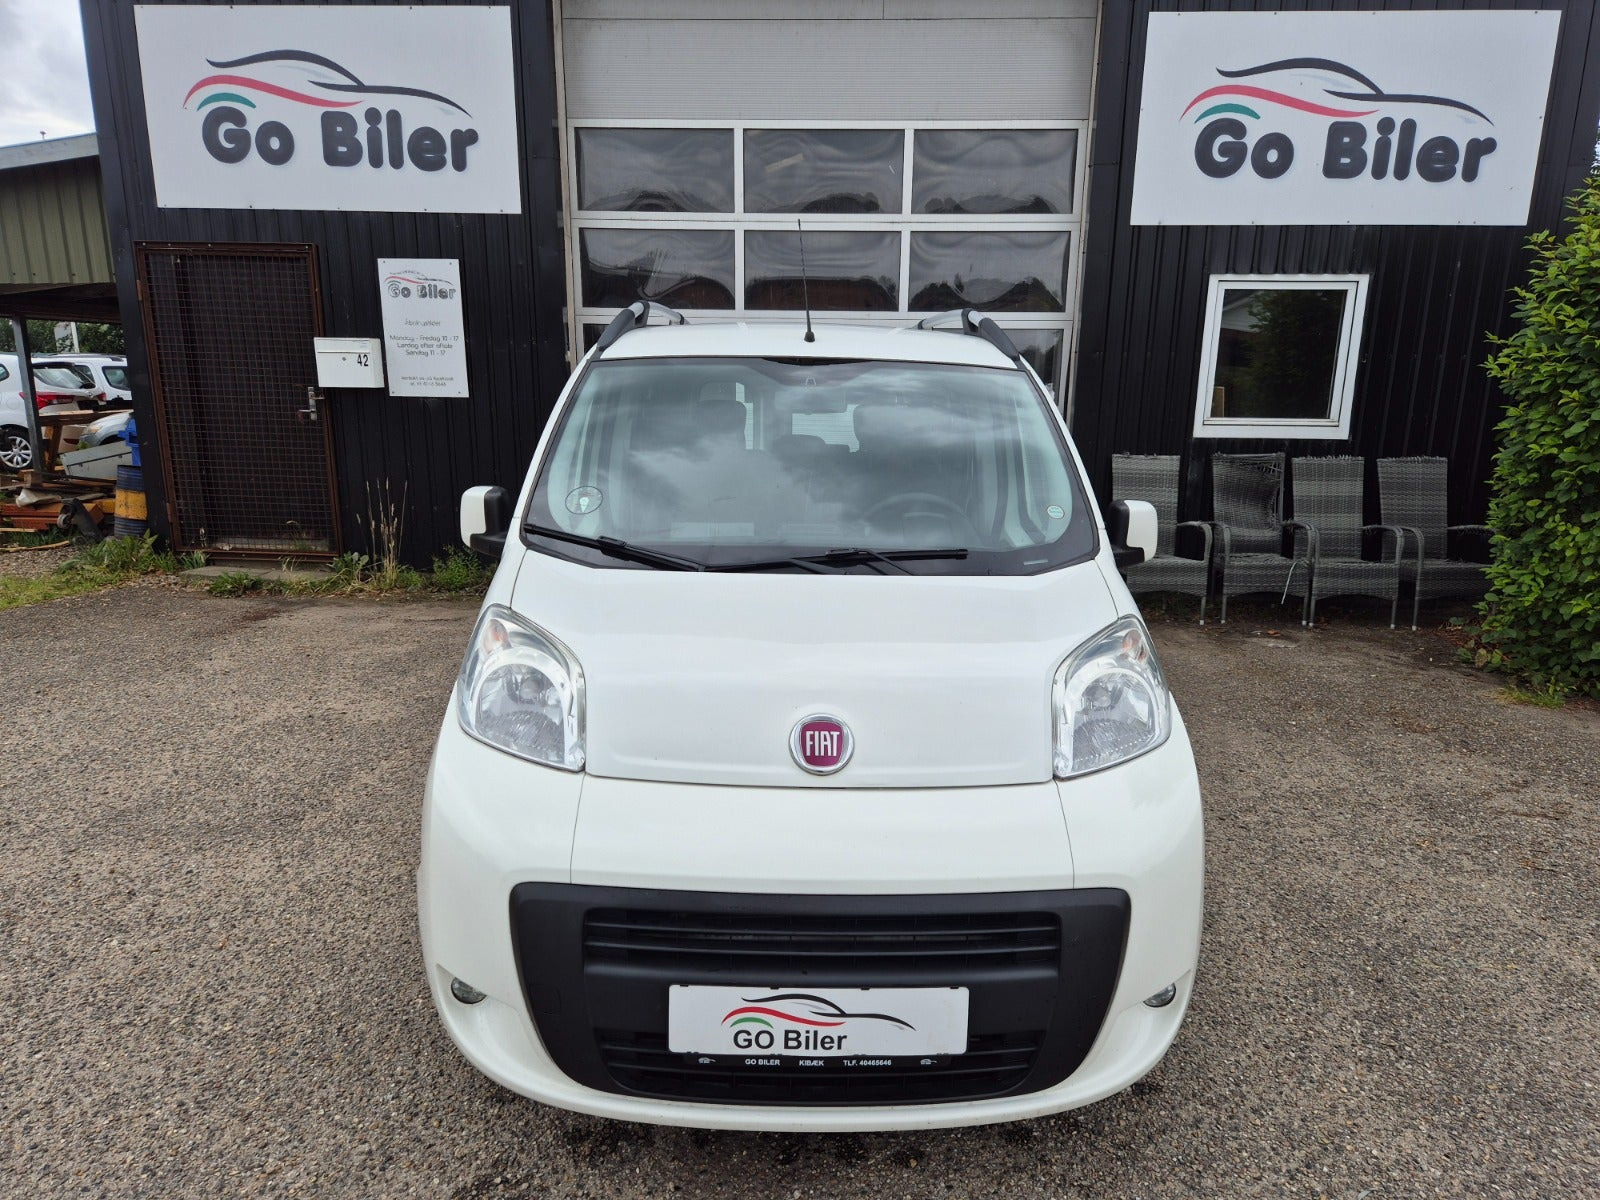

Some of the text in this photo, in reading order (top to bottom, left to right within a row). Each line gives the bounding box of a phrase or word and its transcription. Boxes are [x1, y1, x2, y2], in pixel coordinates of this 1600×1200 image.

[202, 106, 479, 172] Go Biler
[1194, 117, 1497, 183] Go Biler
[388, 283, 456, 299] Go Biler
[357, 354, 368, 367] 42
[805, 730, 840, 757] FIAT
[733, 1029, 847, 1050] GO Biler
